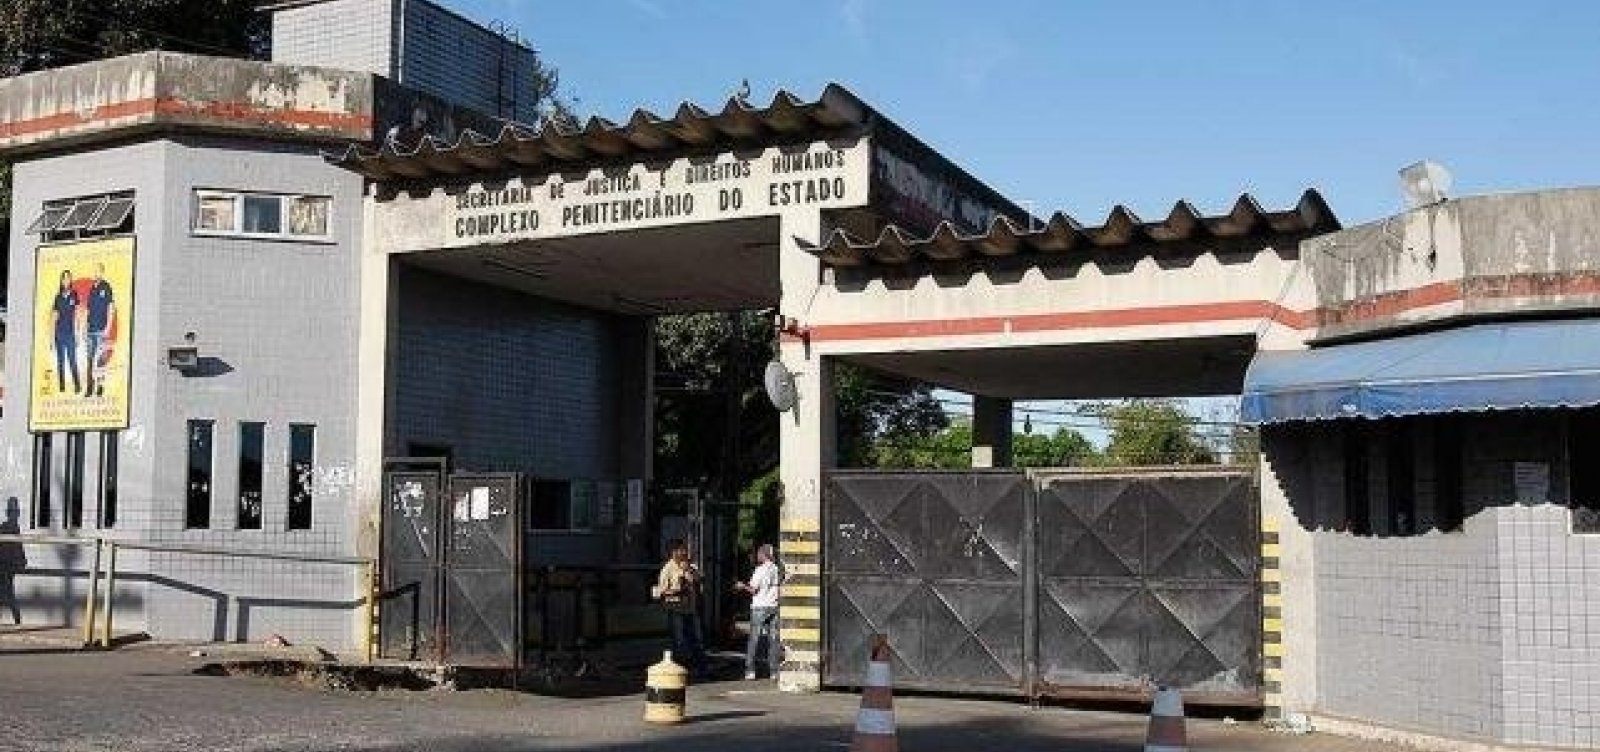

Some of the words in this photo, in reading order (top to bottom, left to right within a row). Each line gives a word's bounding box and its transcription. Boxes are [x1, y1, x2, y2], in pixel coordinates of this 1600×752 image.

[550, 182, 564, 199] DE
[685, 160, 751, 184] DIREITOS
[772, 150, 846, 174] HUMANOS
[456, 210, 539, 238] COMPLEXO
[563, 190, 694, 228] PENITENCIÁRIO
[719, 187, 743, 211] DO
[769, 176, 846, 206] ESTADO
